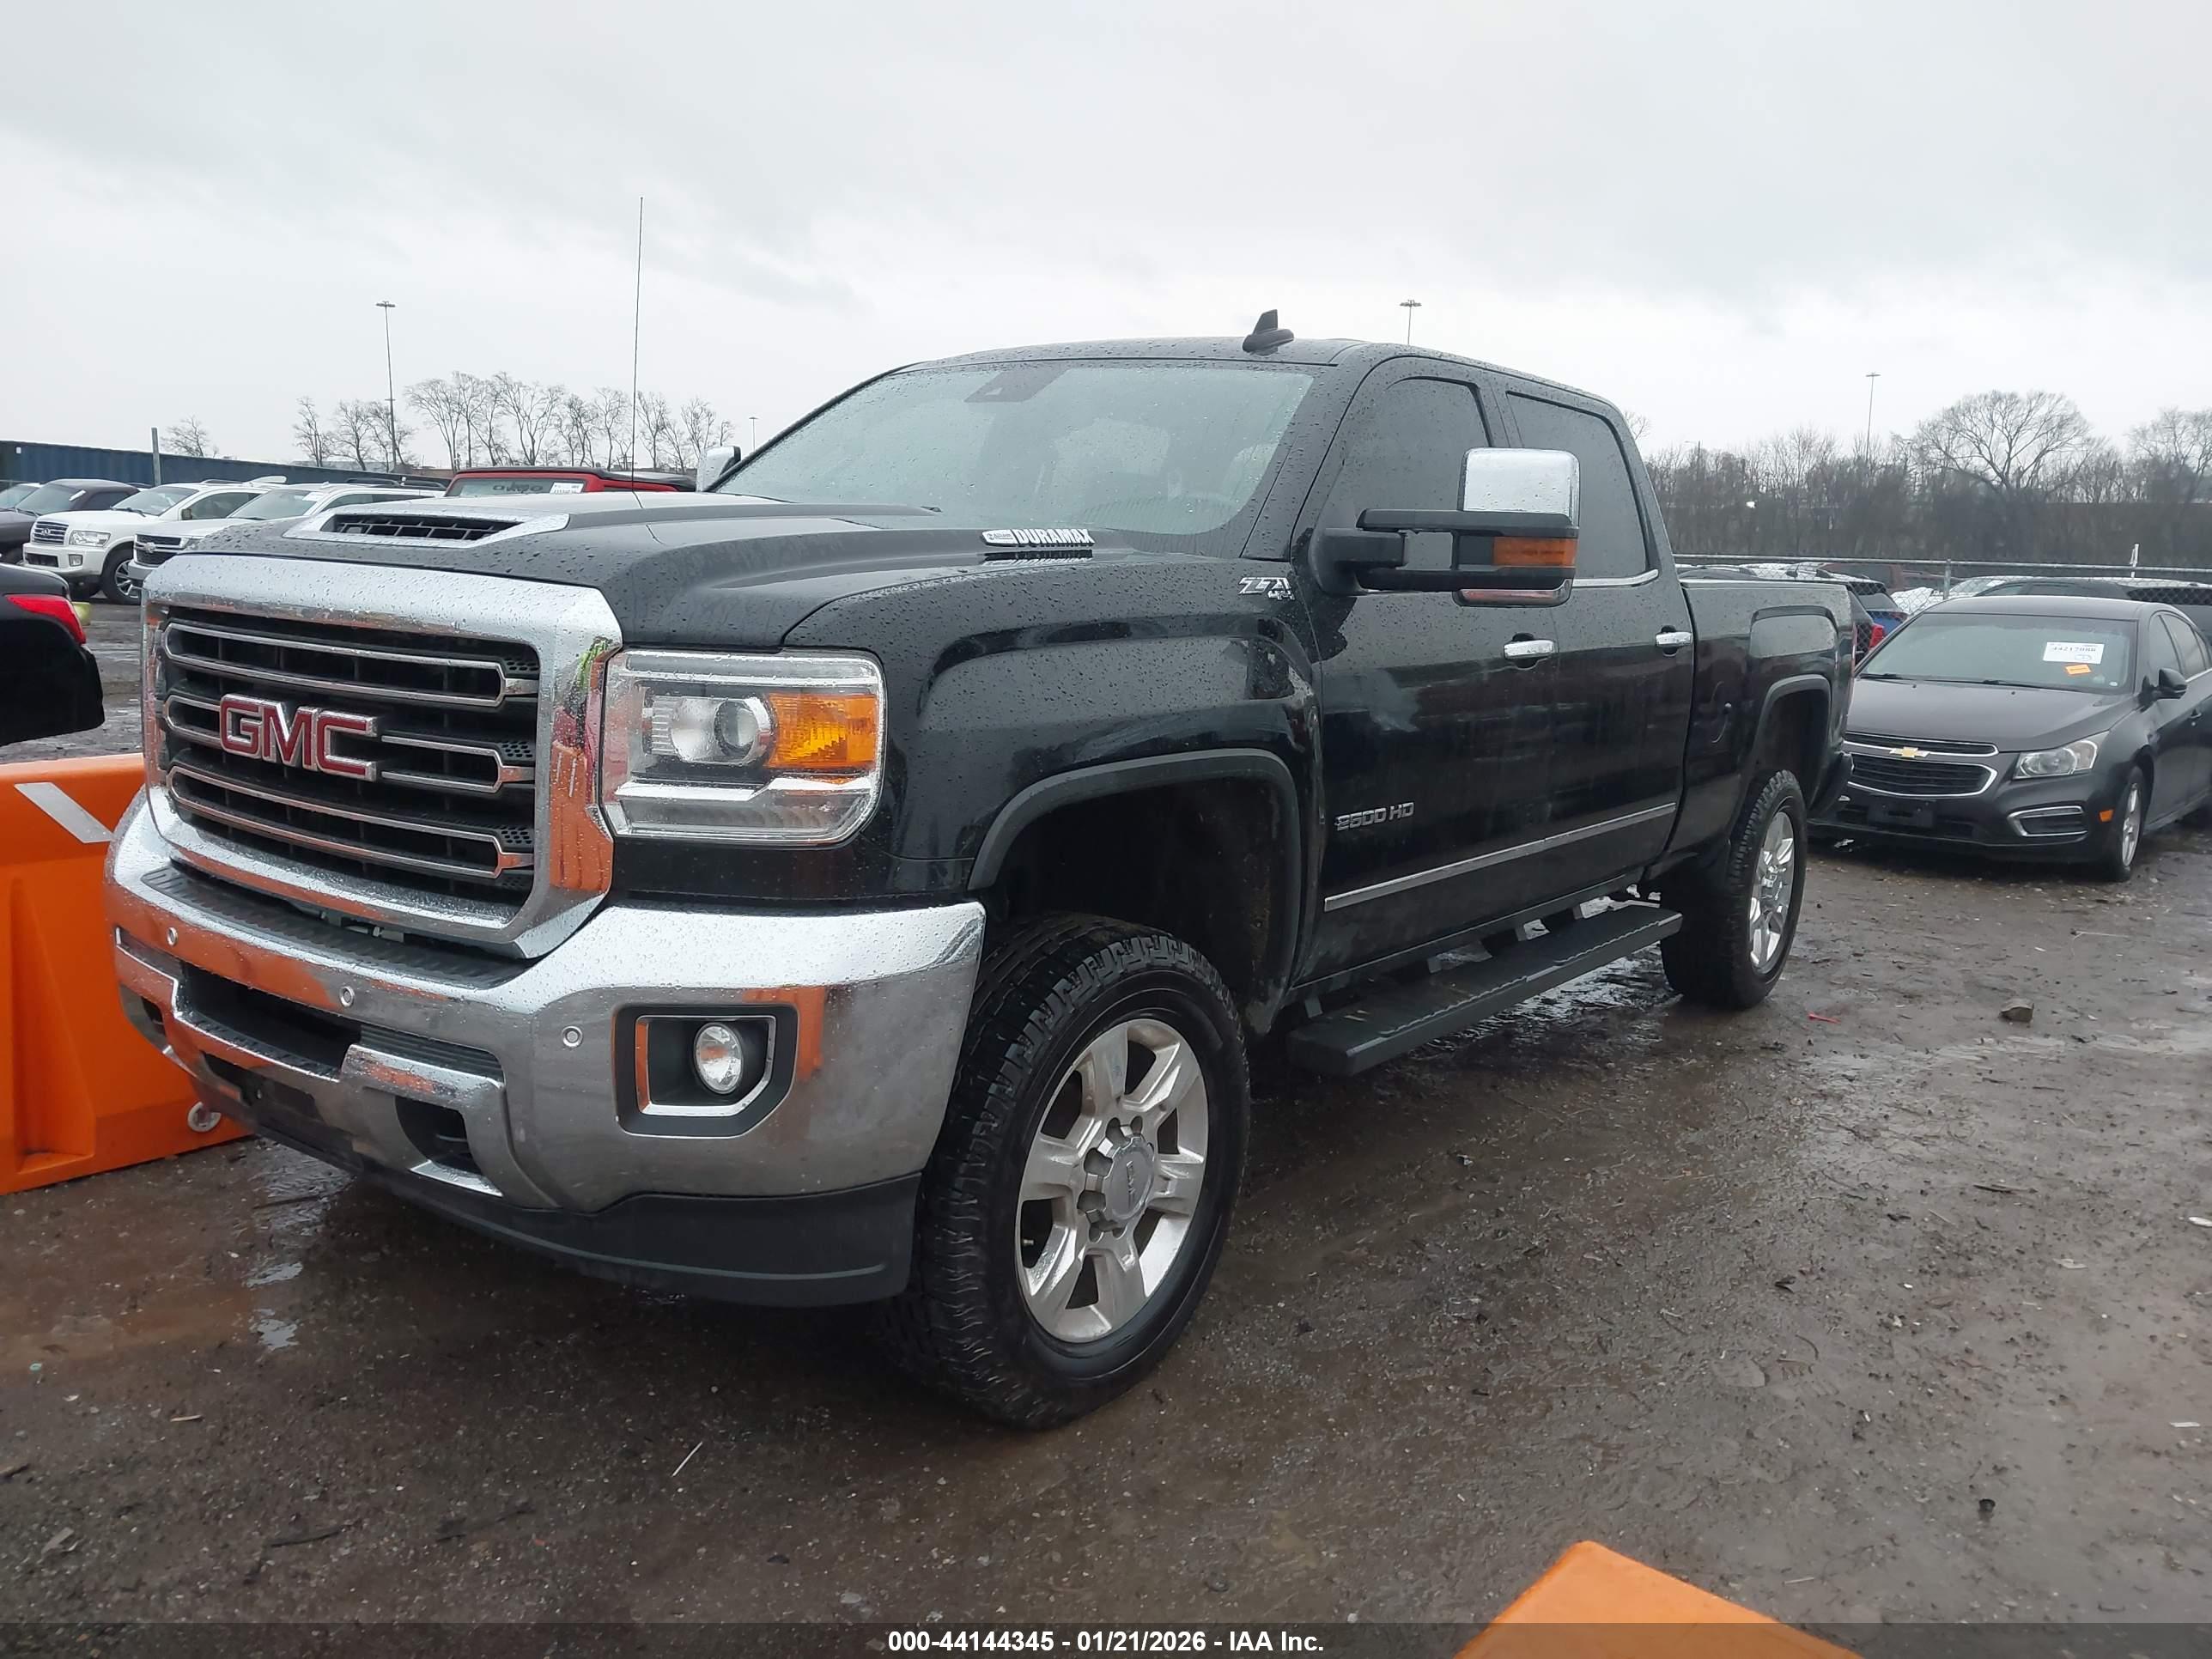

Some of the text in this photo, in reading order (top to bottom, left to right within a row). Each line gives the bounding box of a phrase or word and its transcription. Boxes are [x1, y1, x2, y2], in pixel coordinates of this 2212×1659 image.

[1012, 528, 1096, 545] DURAMAX
[220, 693, 379, 782] GMC
[1334, 802, 1415, 831] 2500 HD
